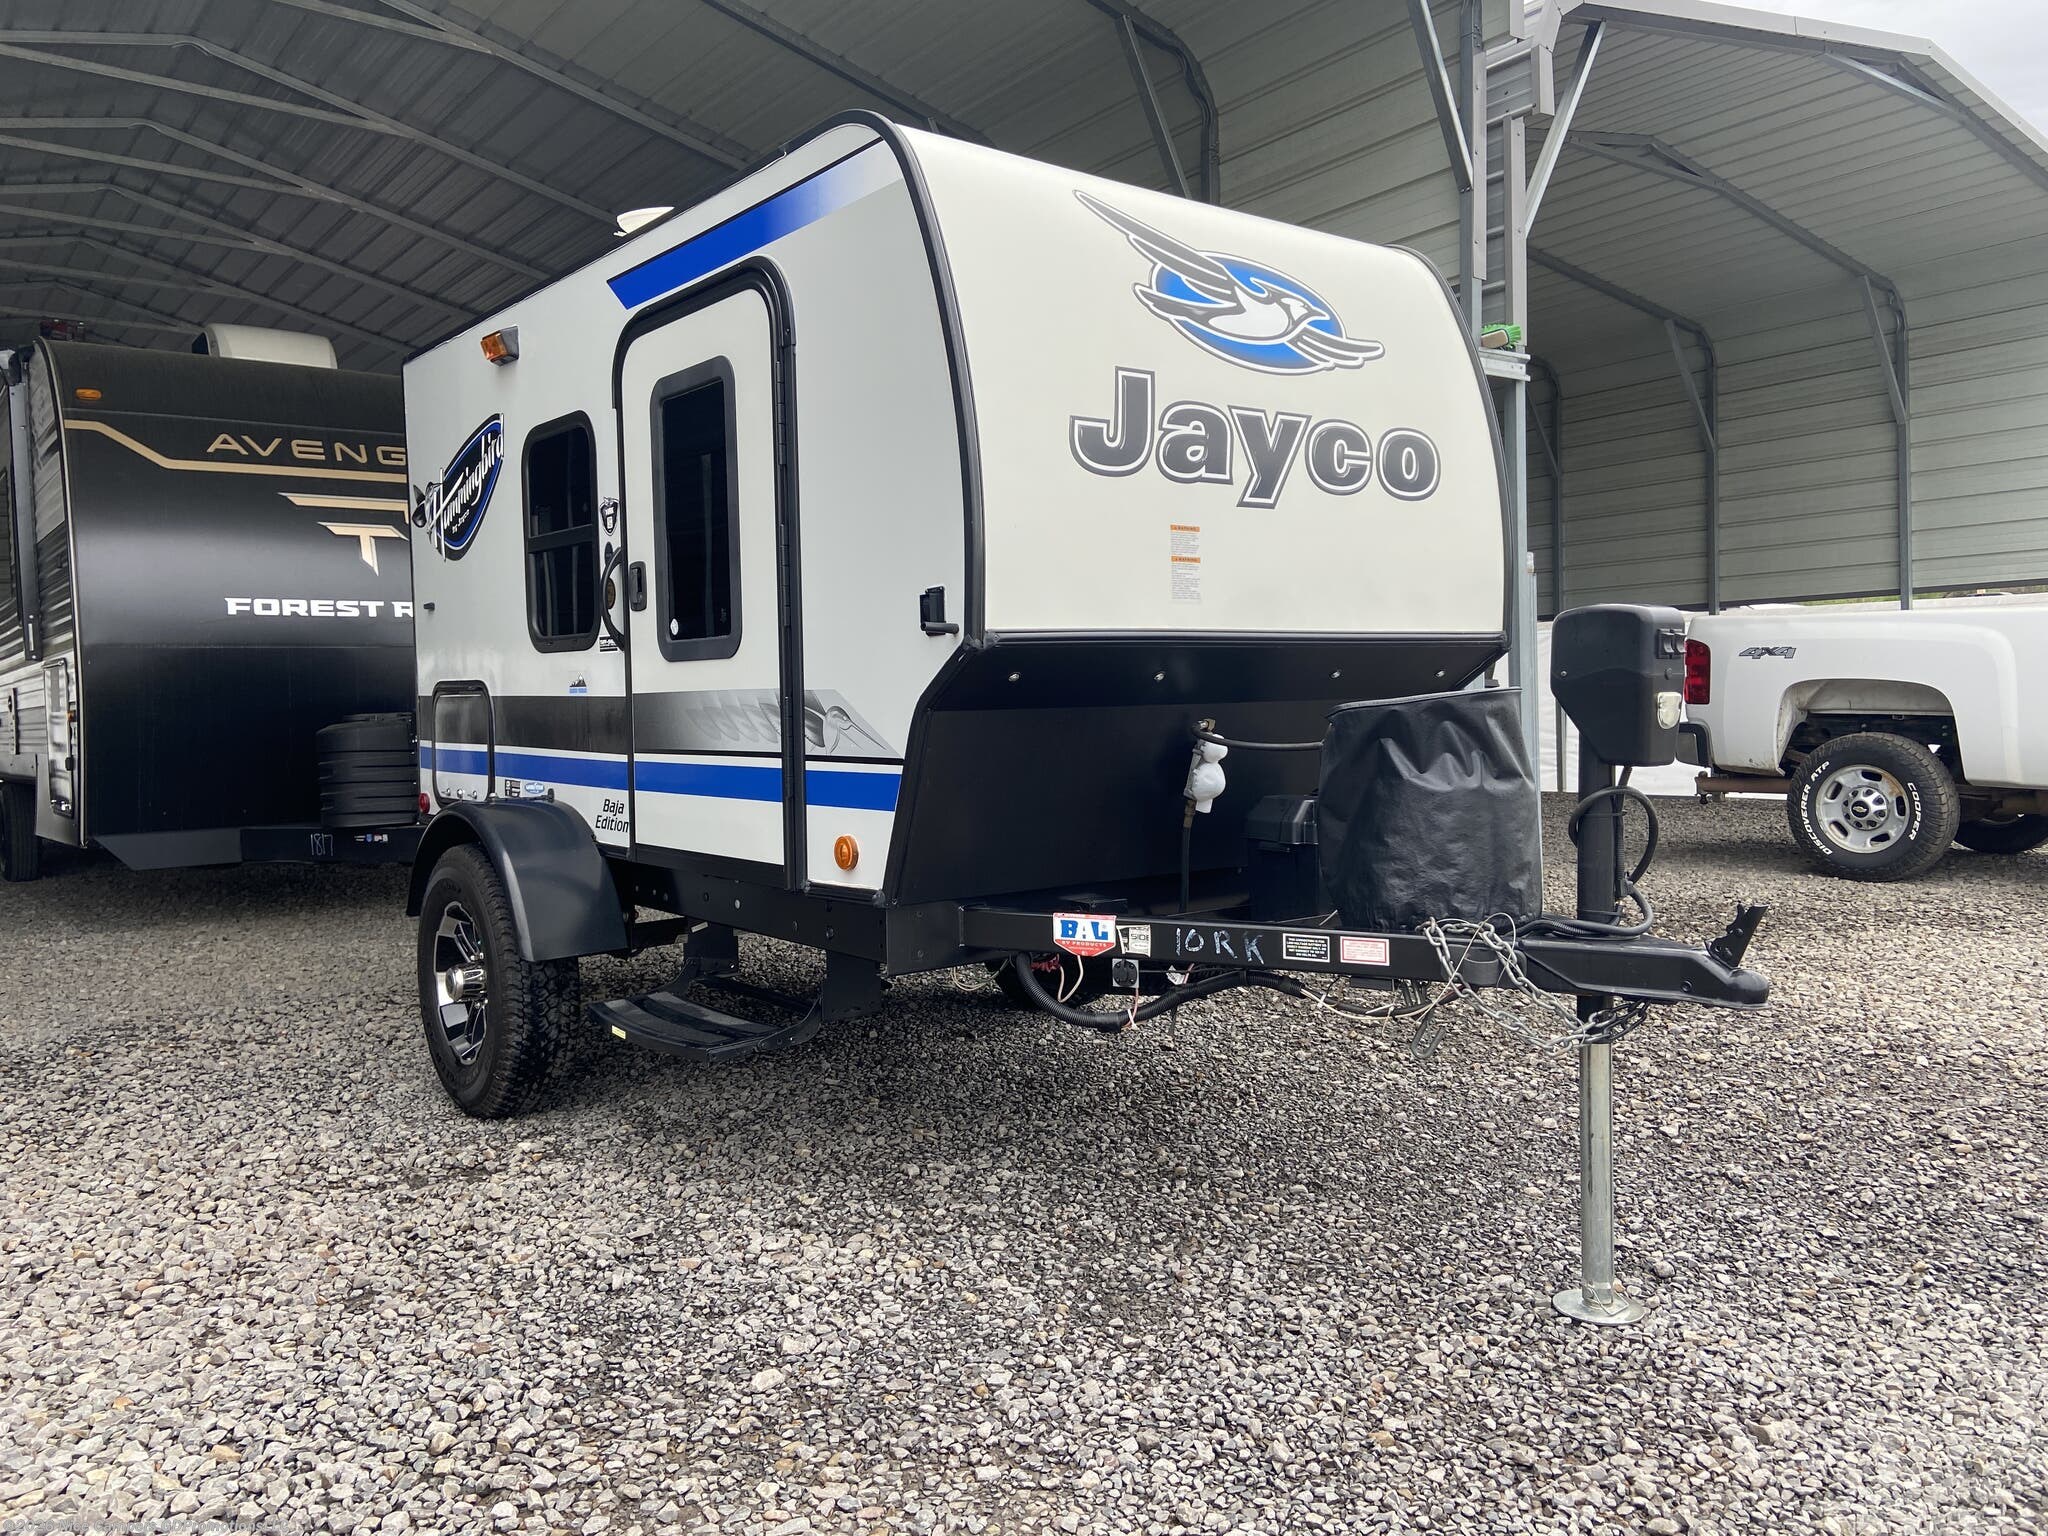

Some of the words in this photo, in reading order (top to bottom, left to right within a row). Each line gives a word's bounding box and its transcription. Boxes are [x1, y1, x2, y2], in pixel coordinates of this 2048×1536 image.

[1069, 366, 1441, 509] Jayco
[427, 413, 505, 562] Hummingbird
[224, 597, 385, 617] FOREST
[1810, 760, 1831, 782] ATP
[603, 798, 625, 816] Baja
[1906, 781, 1922, 841] COOPER
[595, 814, 630, 833] Edition
[1800, 783, 1833, 856] DISCOVERER
[1072, 940, 1108, 948] PRODUCTS
